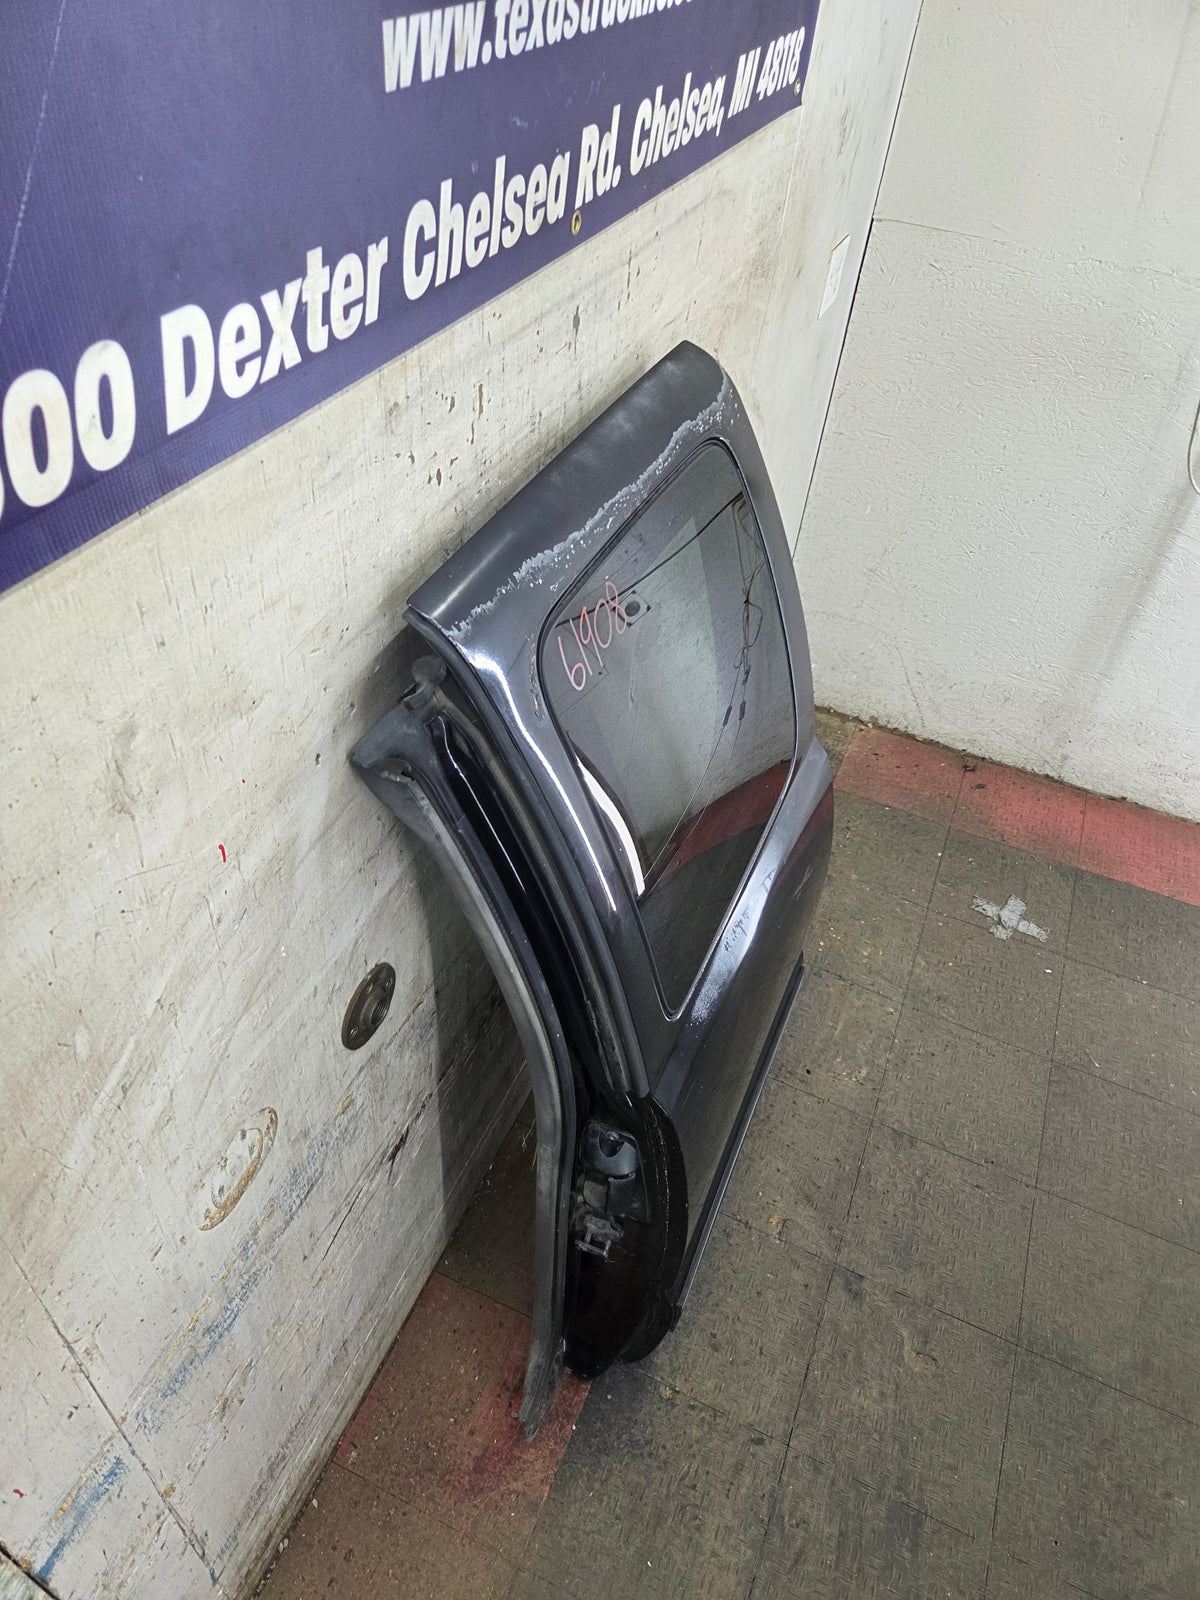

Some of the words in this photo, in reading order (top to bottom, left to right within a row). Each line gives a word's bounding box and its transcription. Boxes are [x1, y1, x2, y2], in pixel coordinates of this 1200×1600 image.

[0, 339, 137, 522] 00
[160, 236, 389, 435] Dexter
[402, 151, 571, 301] Chelsea
[574, 104, 622, 210] Rd.
[630, 72, 726, 176] Chelsea,
[727, 46, 762, 119] MI
[756, 26, 806, 101] 48118
[557, 580, 628, 691] 61908
